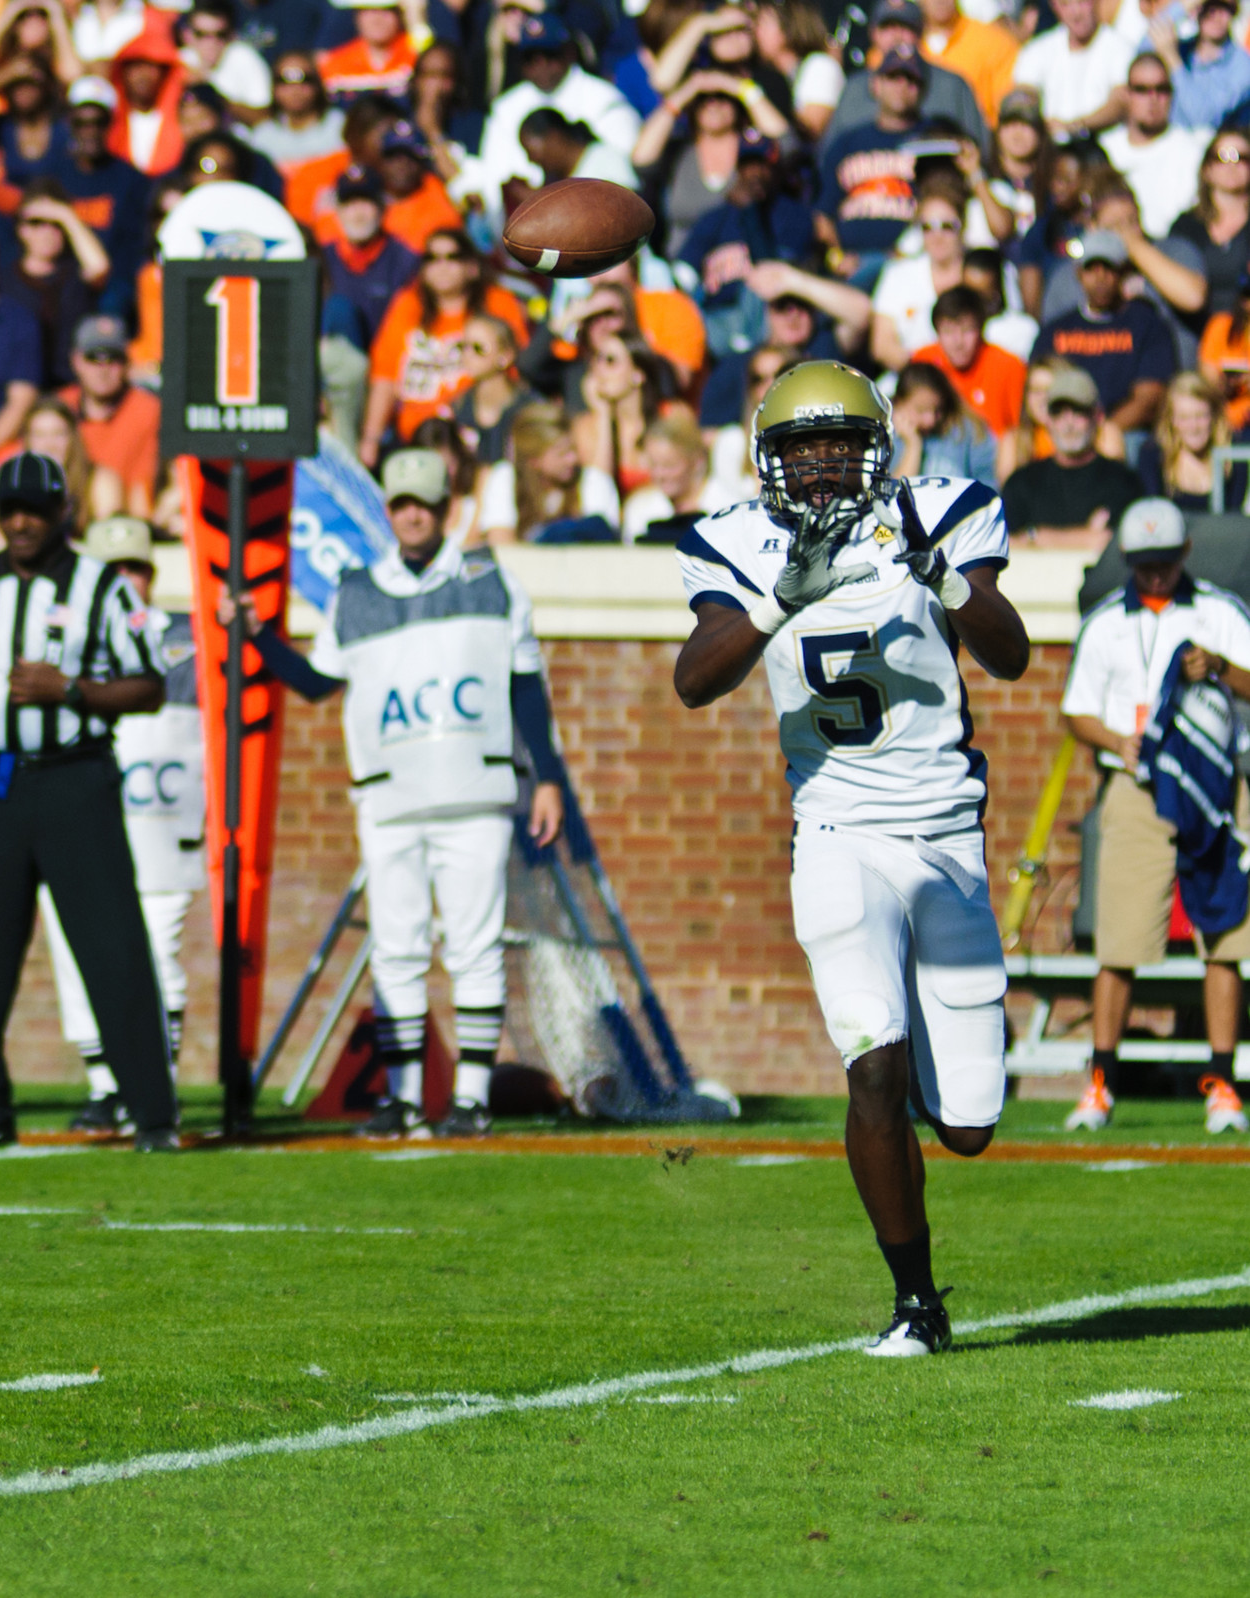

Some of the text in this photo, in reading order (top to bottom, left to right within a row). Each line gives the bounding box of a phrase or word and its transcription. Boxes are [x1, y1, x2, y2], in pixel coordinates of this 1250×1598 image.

[205, 276, 260, 405] 1
[379, 676, 484, 736] ACC
[795, 624, 891, 752] 5
[122, 761, 186, 807] CC
